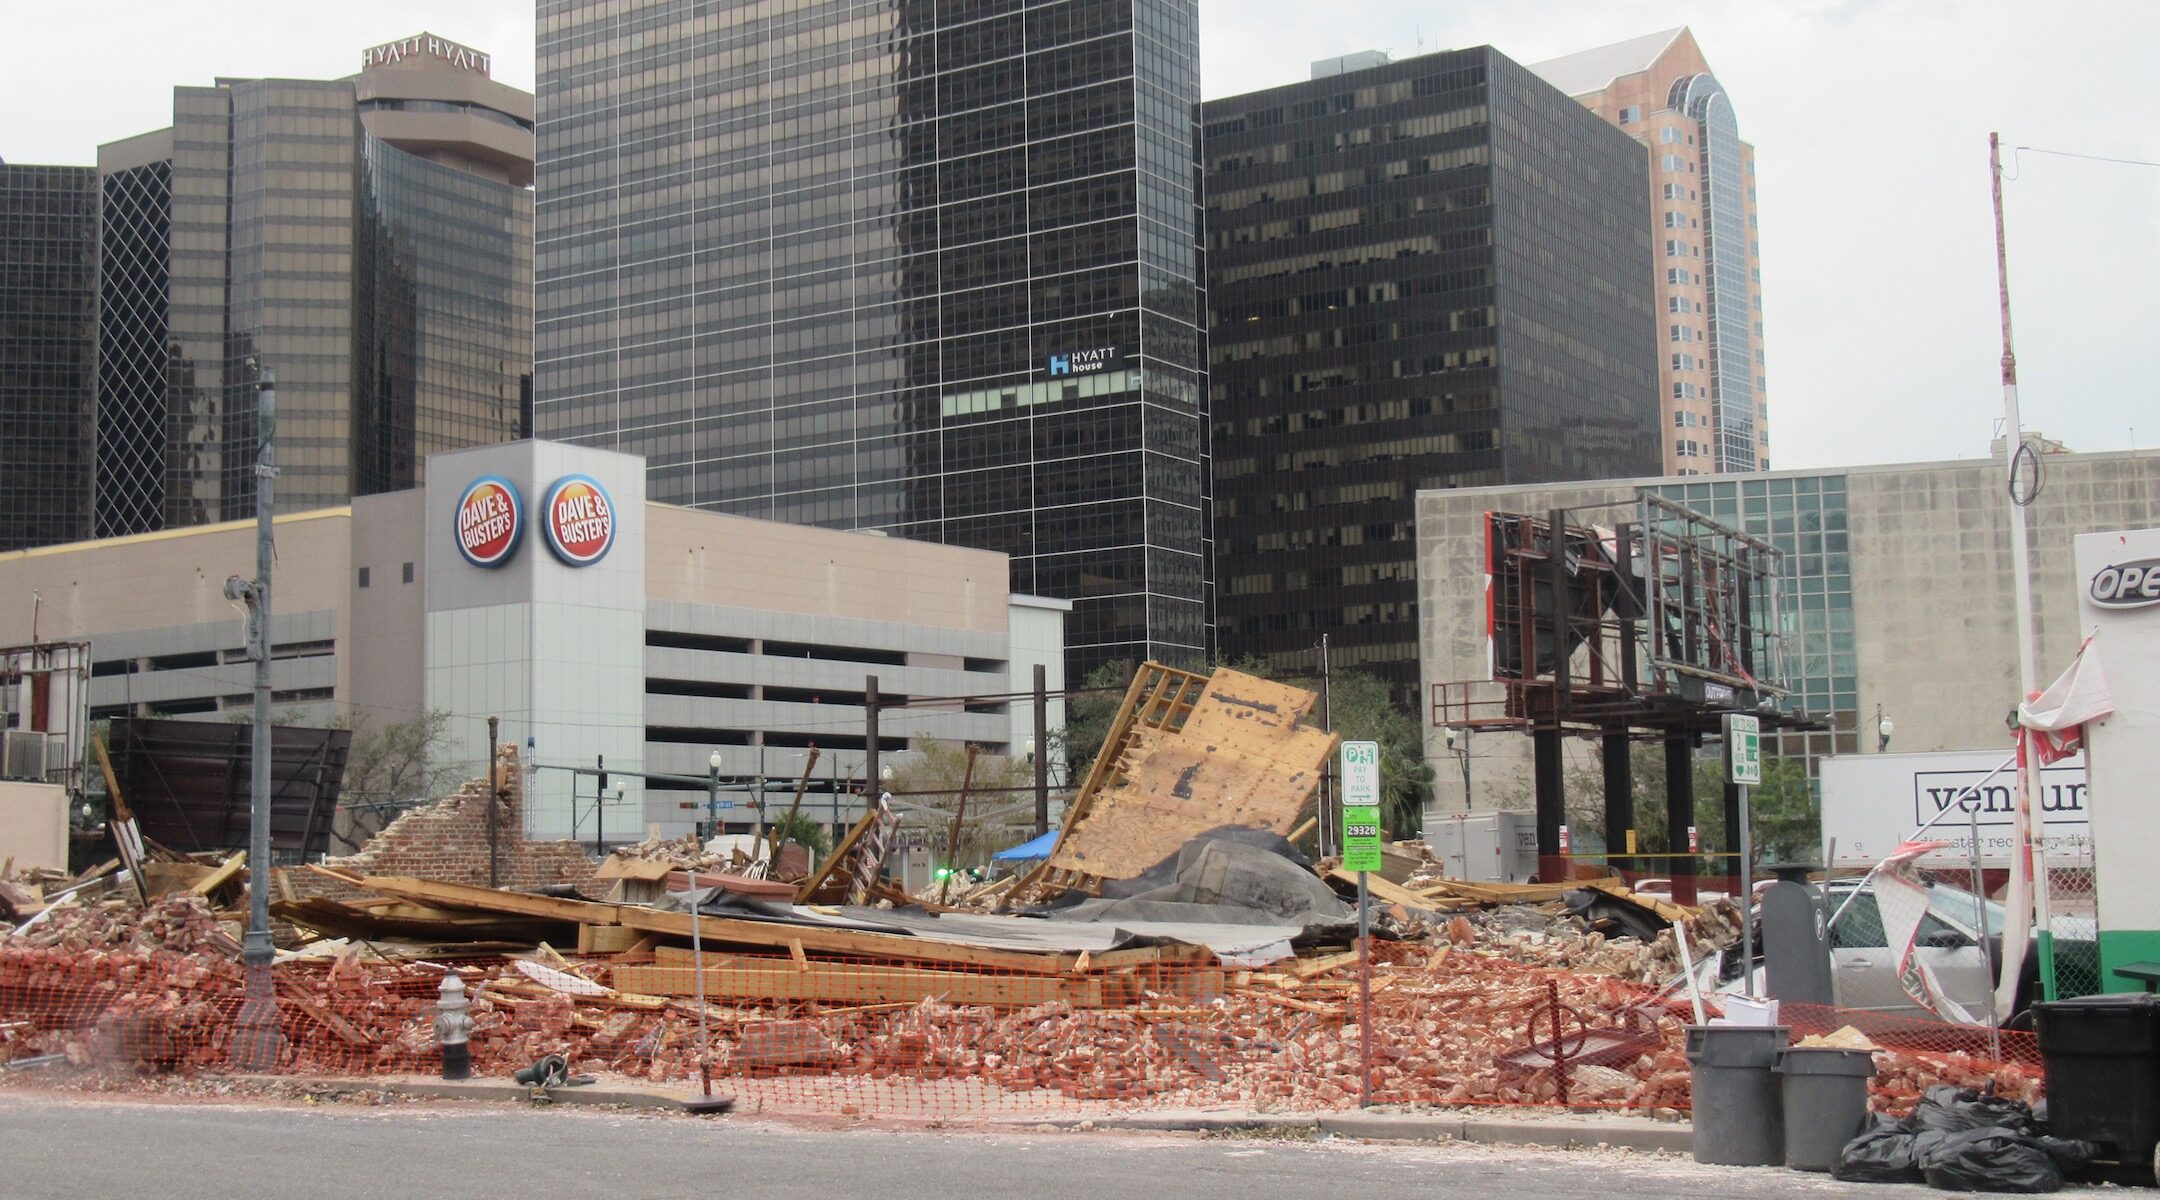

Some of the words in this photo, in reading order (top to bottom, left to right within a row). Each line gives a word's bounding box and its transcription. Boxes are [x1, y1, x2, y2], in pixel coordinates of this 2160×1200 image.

[363, 36, 422, 67] HYATT
[428, 37, 489, 72] HYATT
[1072, 347, 1116, 363] HYATT
[1072, 361, 1103, 373] house
[462, 495, 498, 531] DAVE
[496, 493, 509, 513] &
[558, 495, 597, 525] DAVE
[595, 495, 608, 516] &
[464, 511, 511, 549] BUSTER'S
[560, 516, 610, 544] BUSTER'S
[2093, 567, 2160, 600] OPE
[1926, 783, 2087, 813] venur
[1347, 825, 1376, 836] 29328
